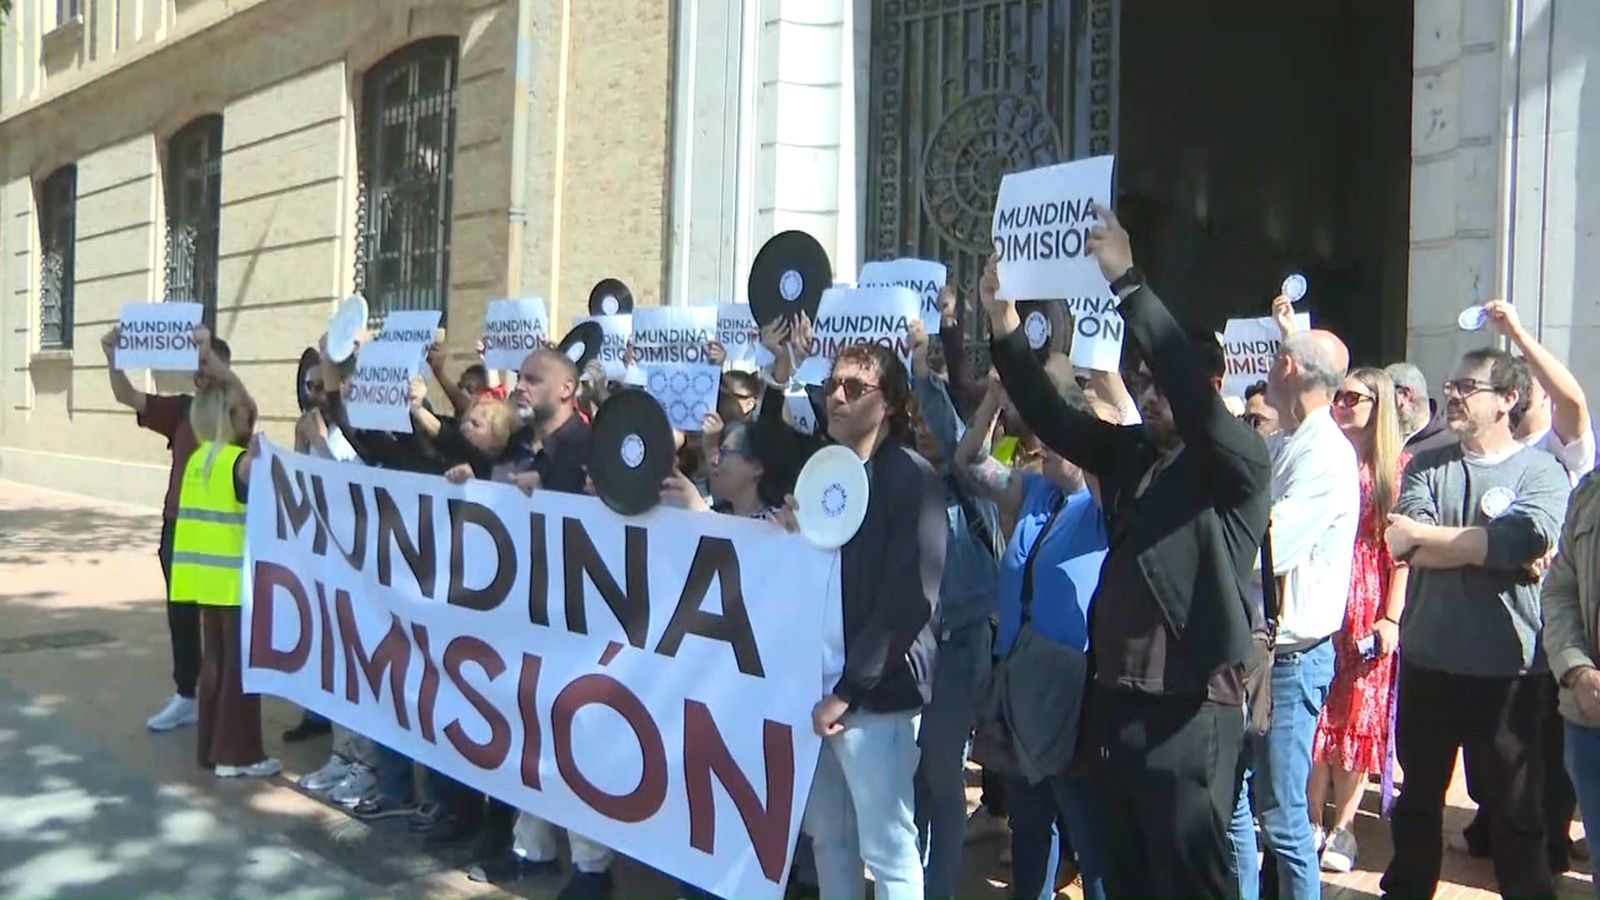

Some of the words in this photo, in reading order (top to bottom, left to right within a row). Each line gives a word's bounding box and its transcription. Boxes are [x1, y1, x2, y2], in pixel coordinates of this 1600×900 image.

[998, 197, 1098, 231] MUNDINA
[120, 320, 194, 333] MUNDINA
[486, 318, 543, 334] MUNDINA
[814, 315, 909, 334] MUNDINA
[634, 329, 710, 343] MUNDINA
[354, 367, 411, 384] MUNDINA
[270, 453, 766, 679] MUNDINA
[248, 560, 795, 885] DIMISIÓN
